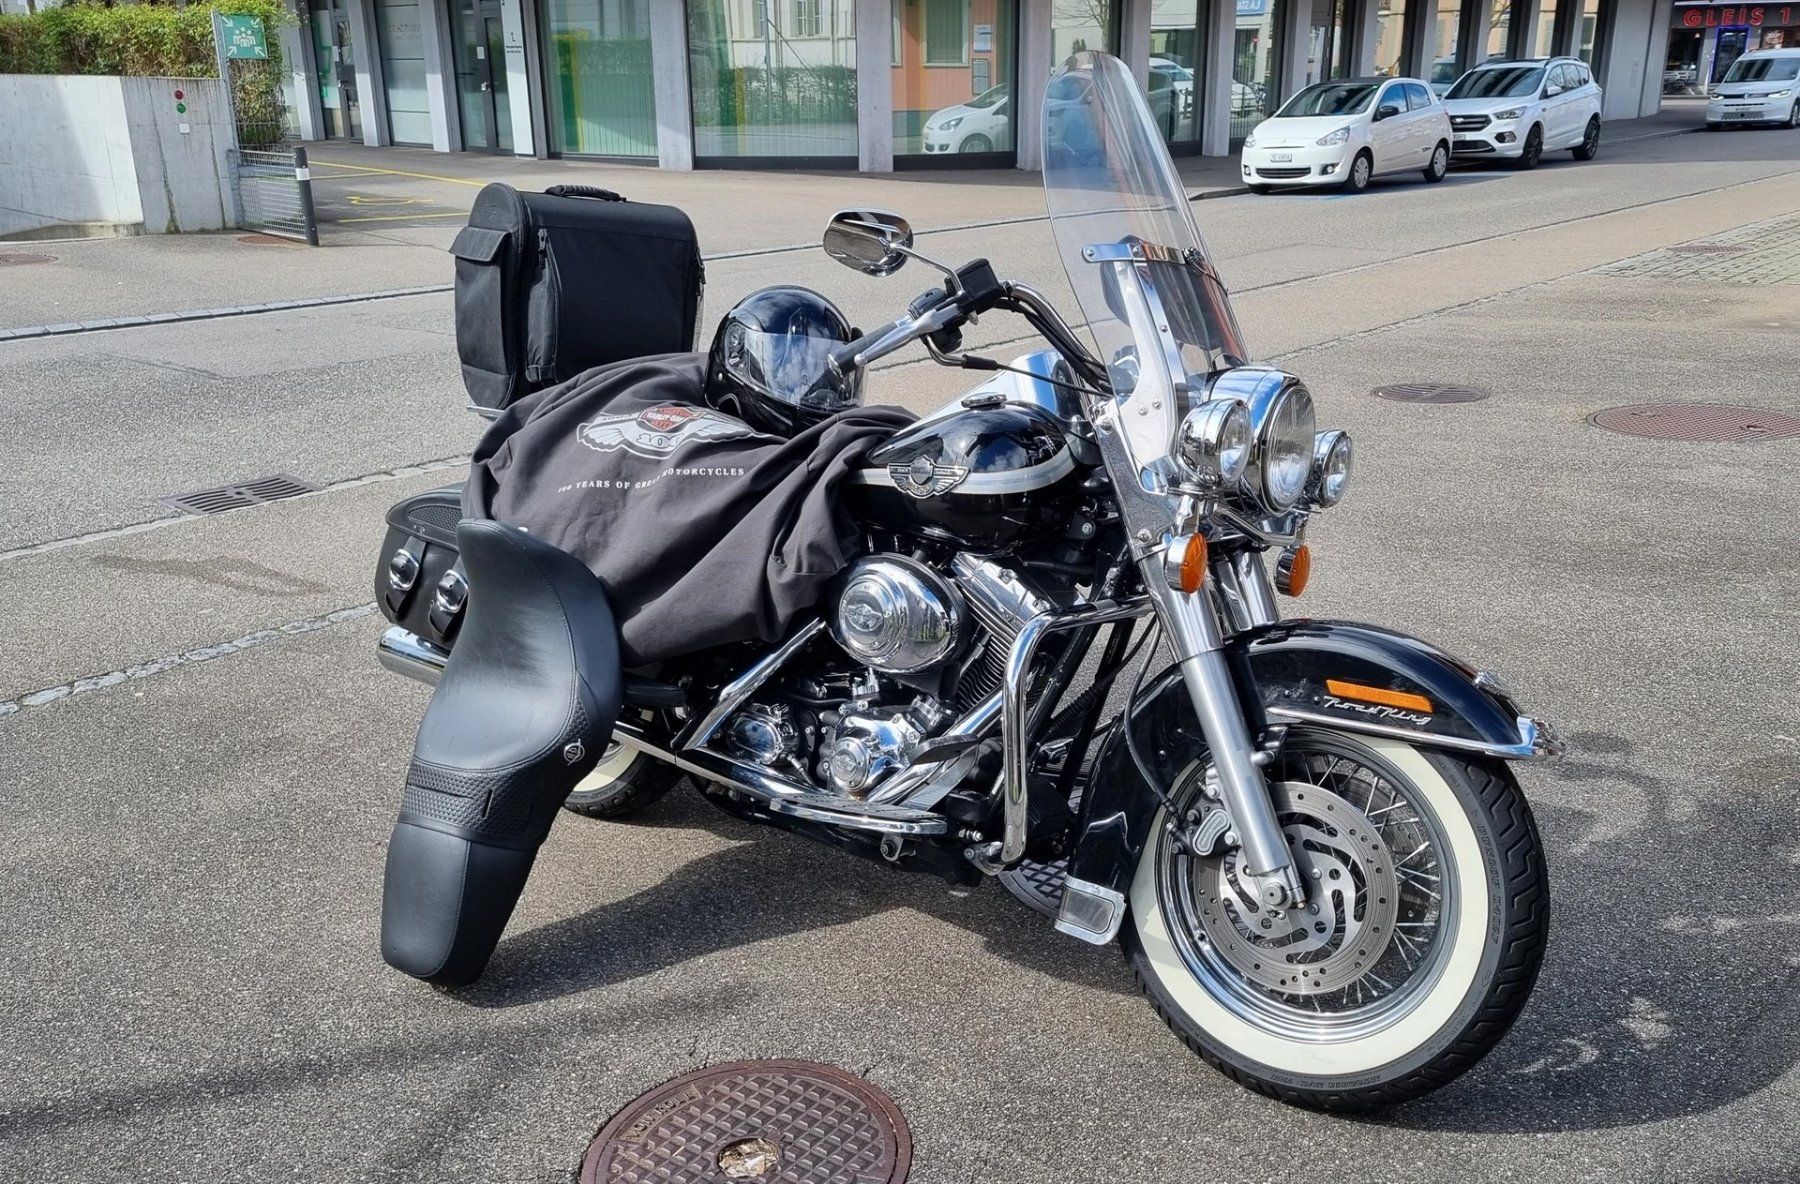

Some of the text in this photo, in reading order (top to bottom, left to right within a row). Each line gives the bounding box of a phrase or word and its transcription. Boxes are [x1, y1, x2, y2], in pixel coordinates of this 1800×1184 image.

[1683, 6, 1764, 27] GLEIS
[576, 480, 610, 488] YEARS
[615, 481, 631, 489] OF
[661, 467, 745, 478] MOTORCYCLES
